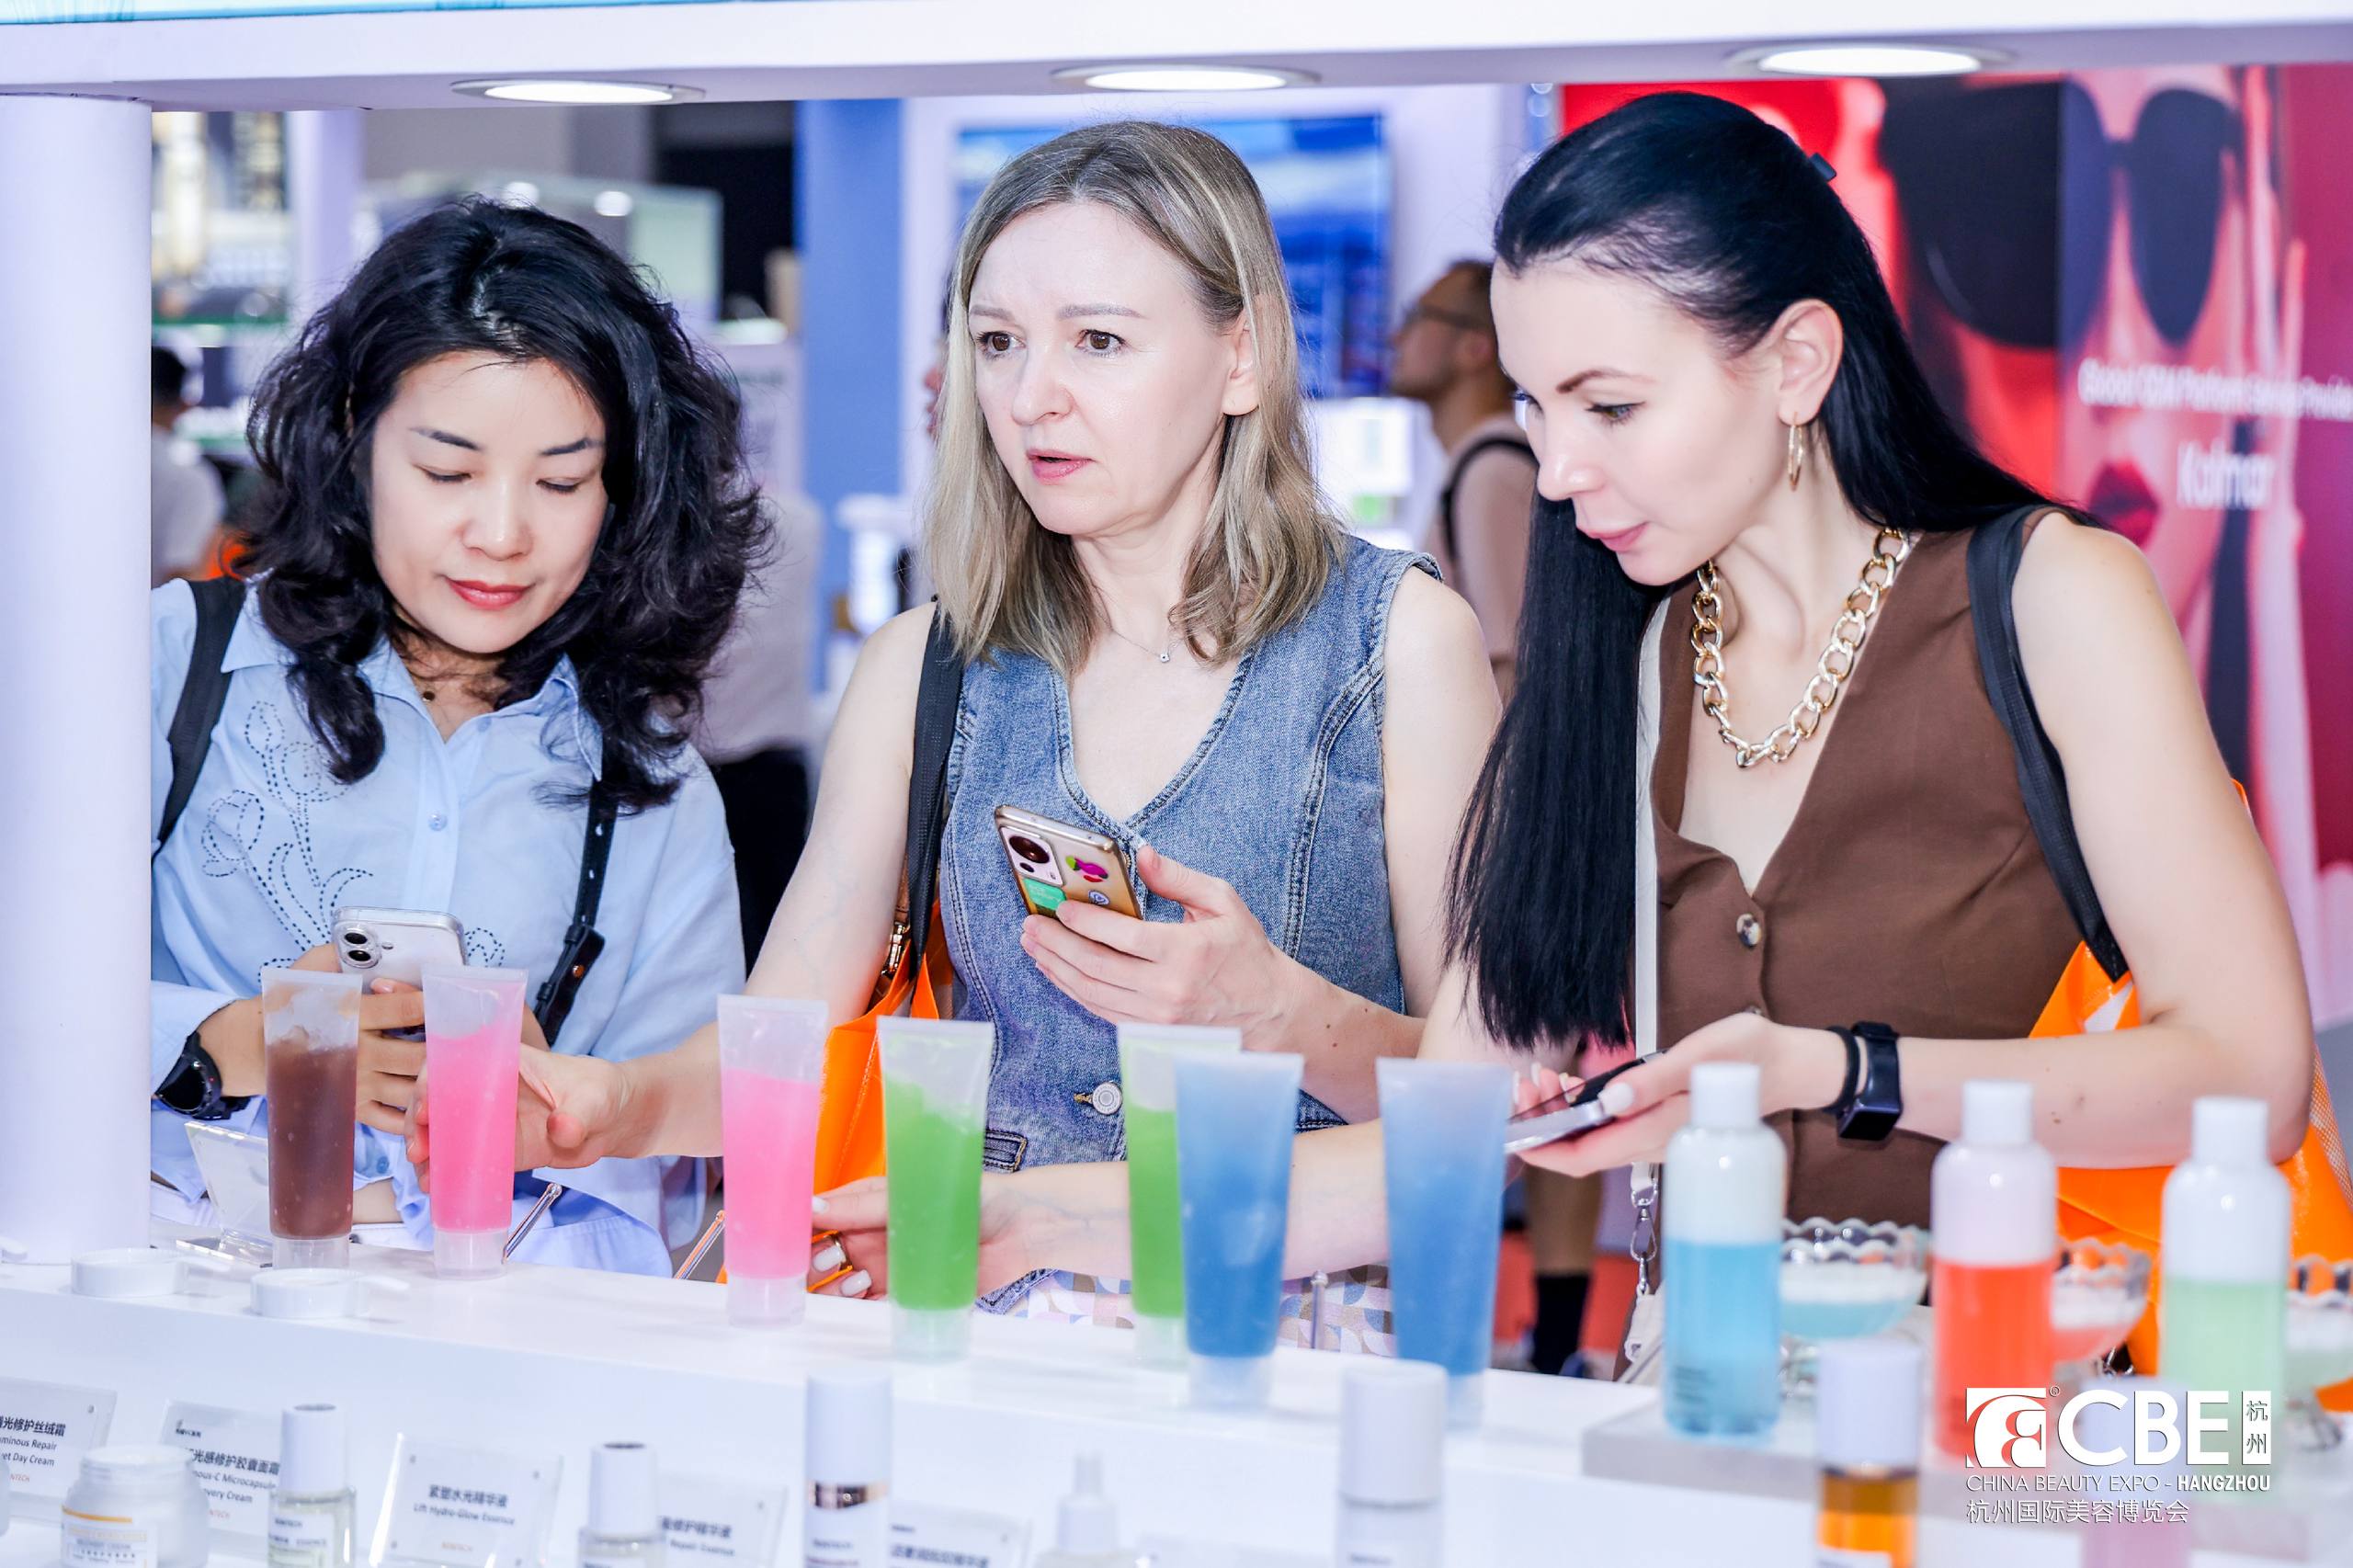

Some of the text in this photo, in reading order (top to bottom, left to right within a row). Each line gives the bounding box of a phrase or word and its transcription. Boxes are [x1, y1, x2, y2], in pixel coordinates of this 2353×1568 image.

[31, 1439, 57, 1451] Repair
[13, 1453, 28, 1464] Day
[29, 1455, 55, 1467] Cream
[226, 1491, 253, 1503] Cream
